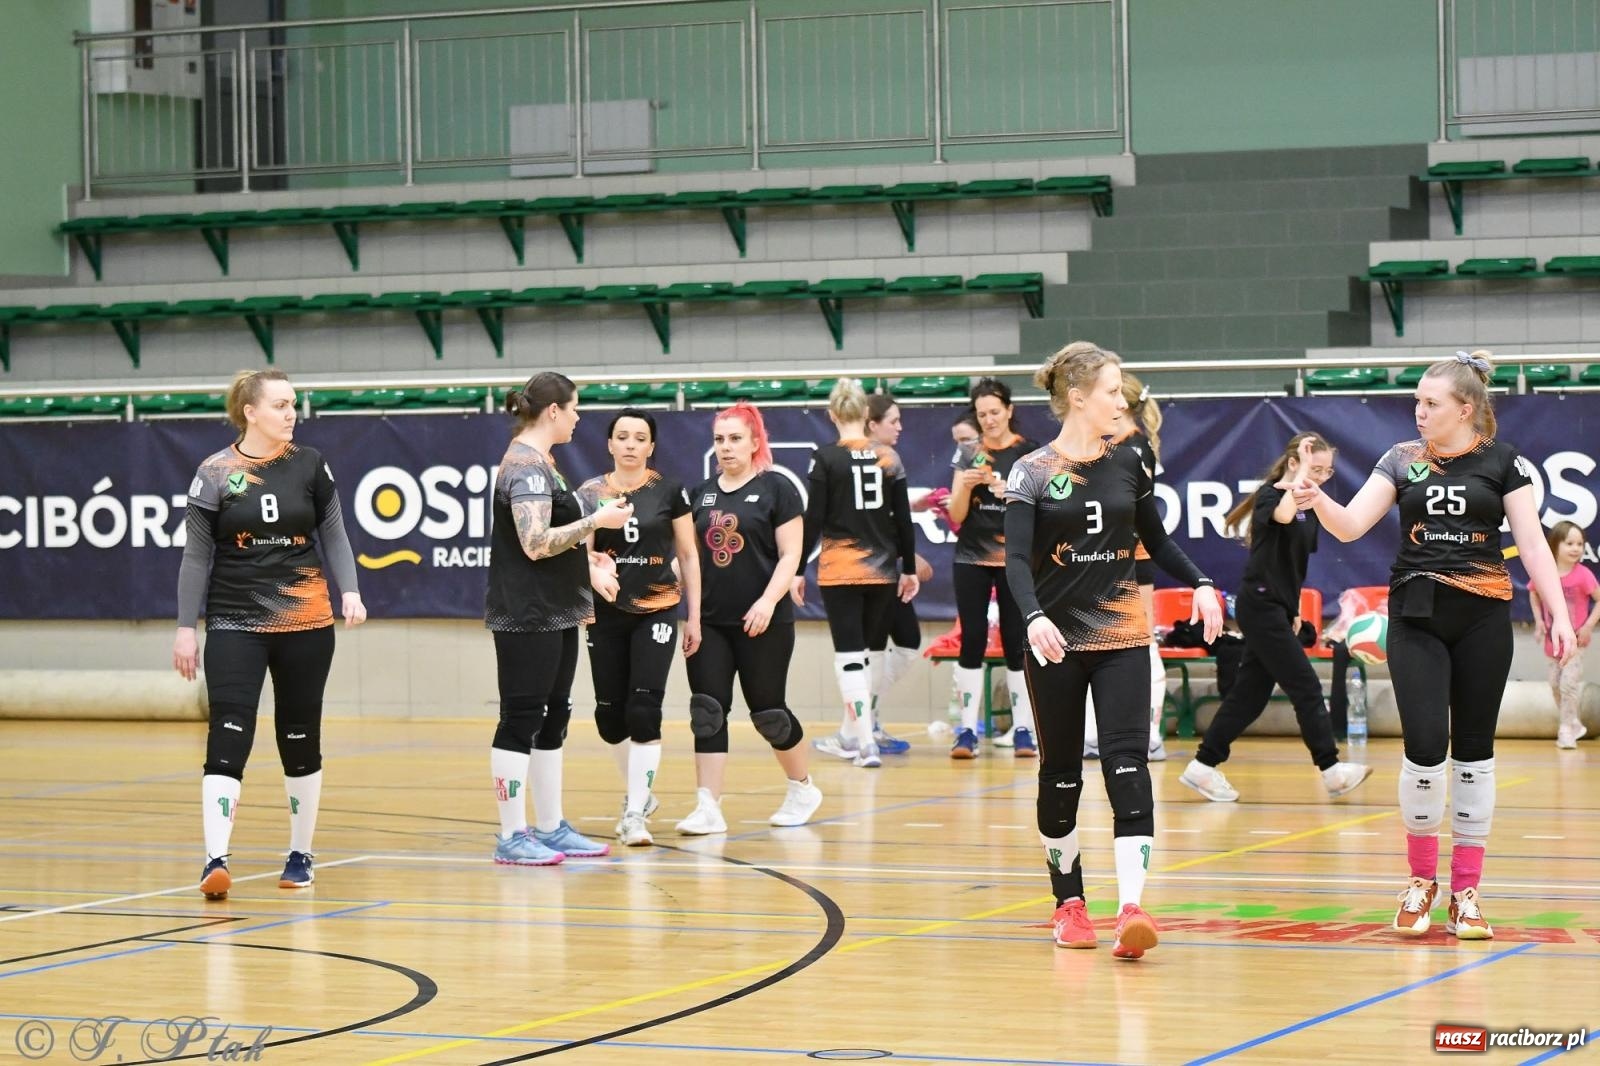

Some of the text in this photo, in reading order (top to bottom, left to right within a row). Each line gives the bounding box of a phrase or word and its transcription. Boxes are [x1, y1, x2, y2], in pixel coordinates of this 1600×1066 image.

[354, 464, 499, 540] OSi
[851, 465, 884, 510] 13
[1426, 485, 1467, 515] 25
[261, 493, 280, 523] 8
[1085, 500, 1103, 534] 3
[623, 516, 640, 543] 6
[1424, 531, 1489, 544] Fundacja JSW
[649, 556, 664, 566] JSW
[1071, 549, 1131, 563] Fundacja JSW
